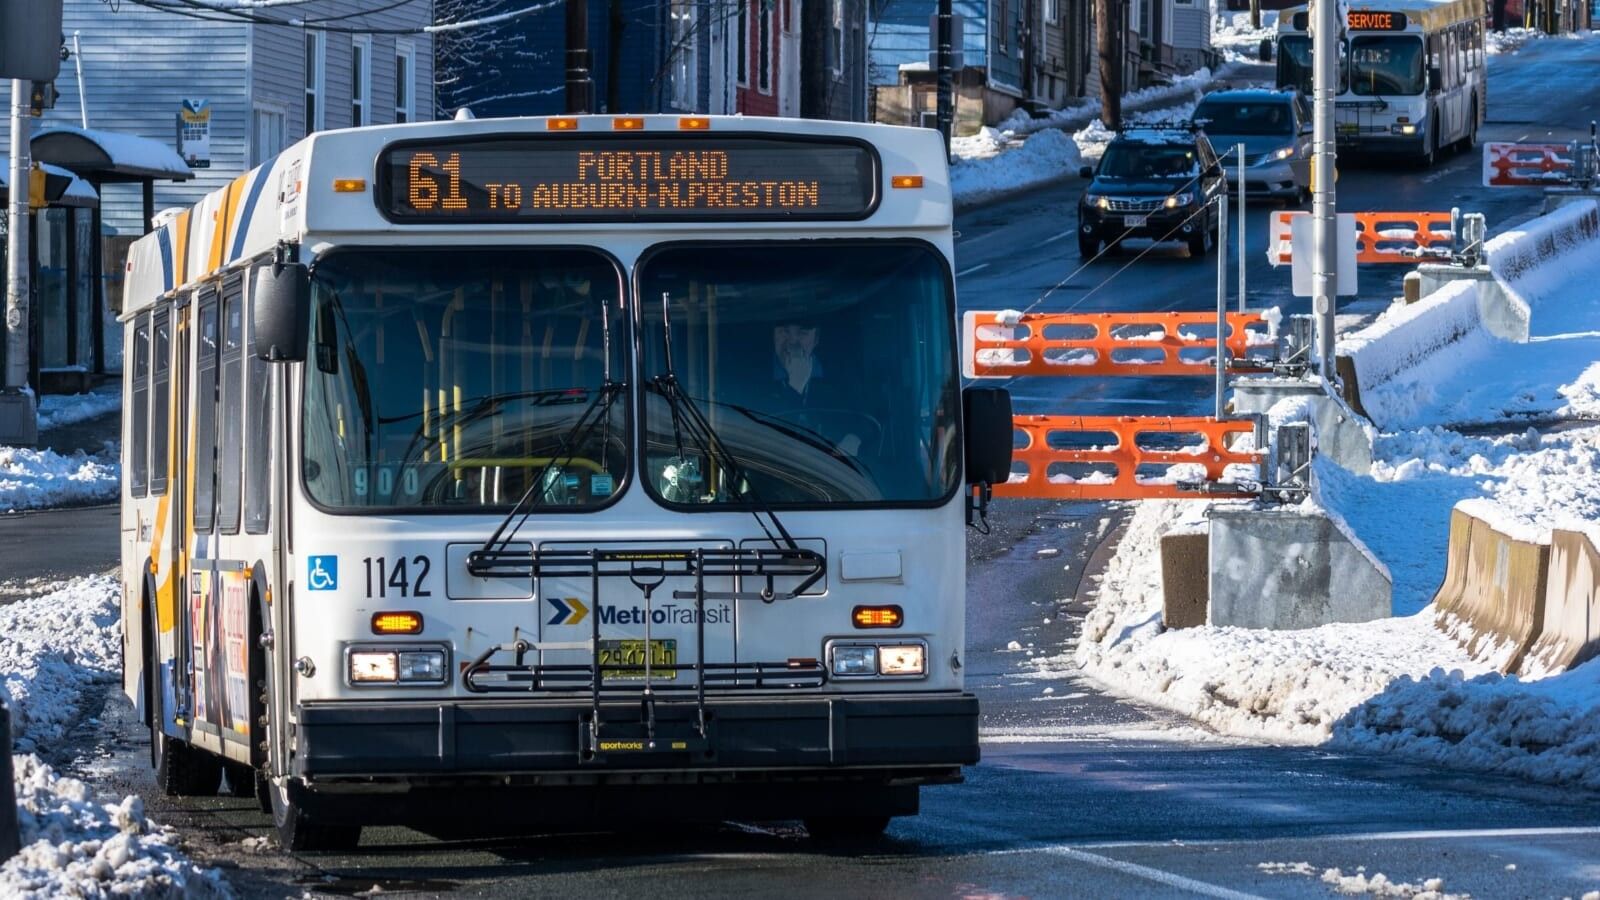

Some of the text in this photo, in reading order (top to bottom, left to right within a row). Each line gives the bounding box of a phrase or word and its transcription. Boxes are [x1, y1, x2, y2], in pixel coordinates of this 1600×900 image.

[1347, 13, 1392, 28] SERVICE
[579, 152, 728, 180] PORTLAND
[409, 153, 467, 208] 61
[485, 182, 818, 208] TO AUBURN-N.PRESTON
[354, 467, 419, 496] 900
[362, 555, 431, 598] 1142
[600, 742, 643, 750] sportworks
